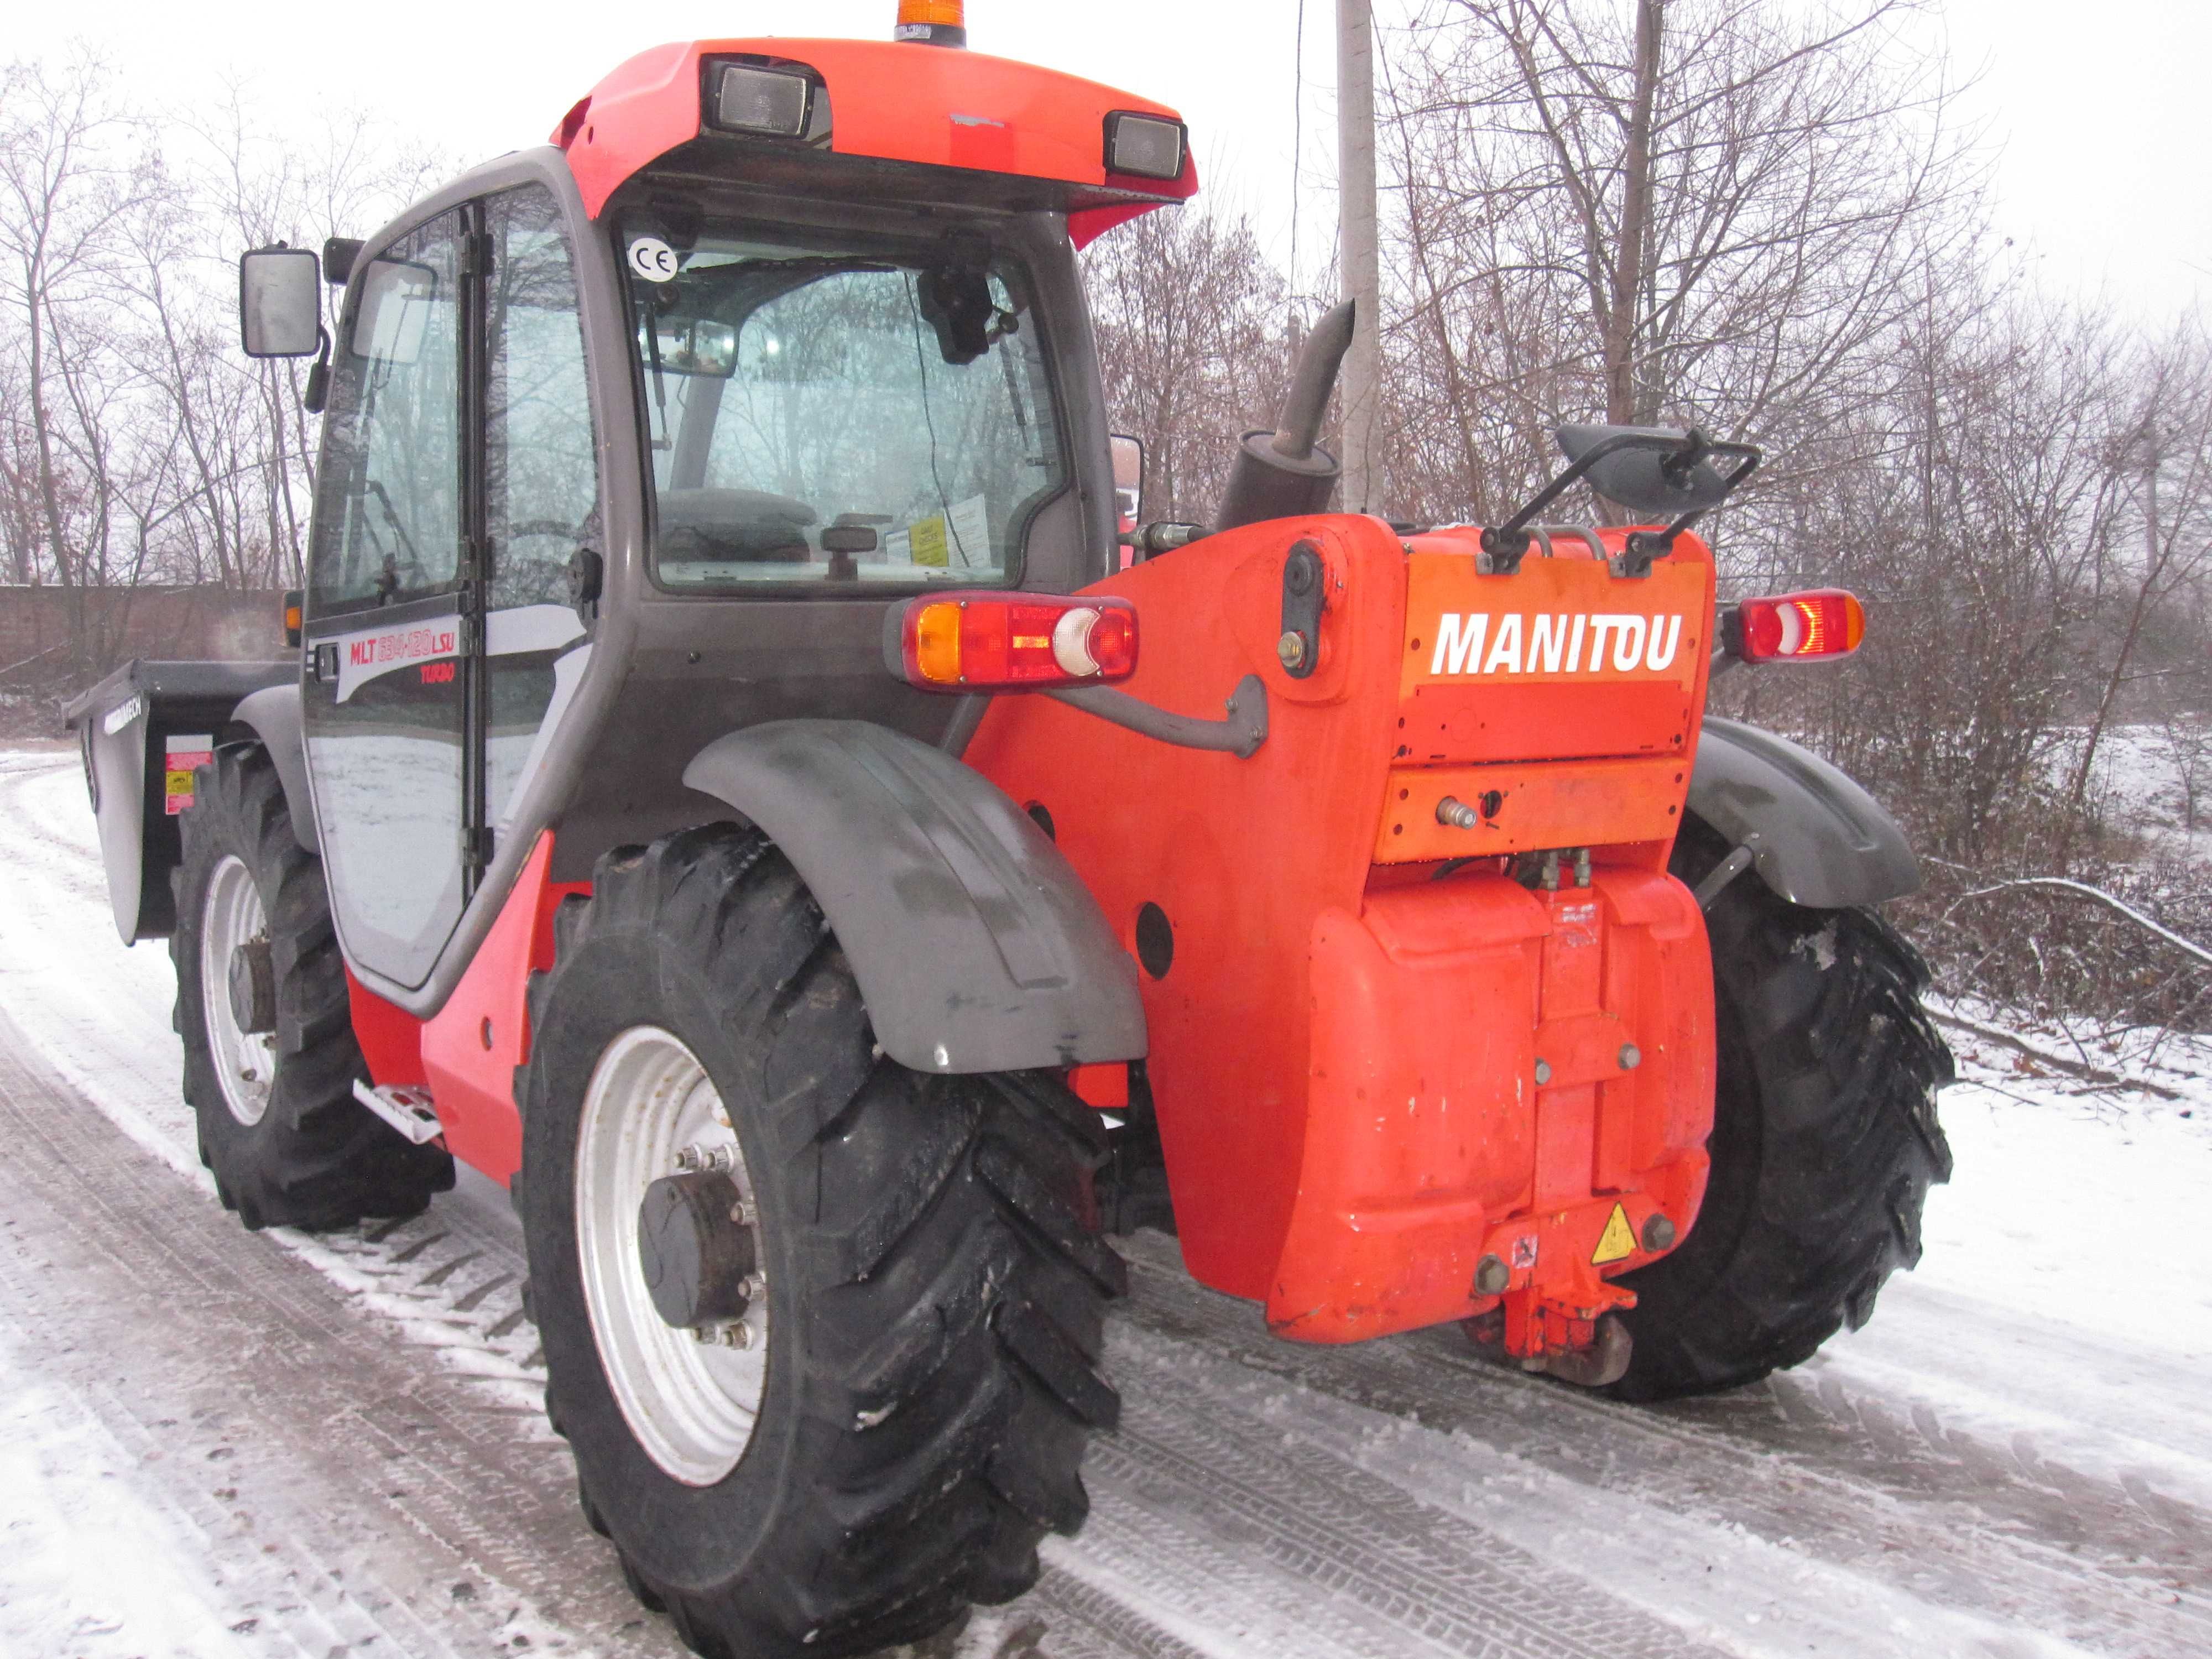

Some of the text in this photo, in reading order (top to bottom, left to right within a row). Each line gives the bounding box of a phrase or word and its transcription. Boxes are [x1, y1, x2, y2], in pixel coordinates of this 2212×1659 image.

[636, 247, 671, 273] CE
[350, 639, 378, 666] MLT
[432, 632, 455, 654] LSU
[1430, 613, 1682, 675] MANITOU
[420, 662, 455, 684] TURBO
